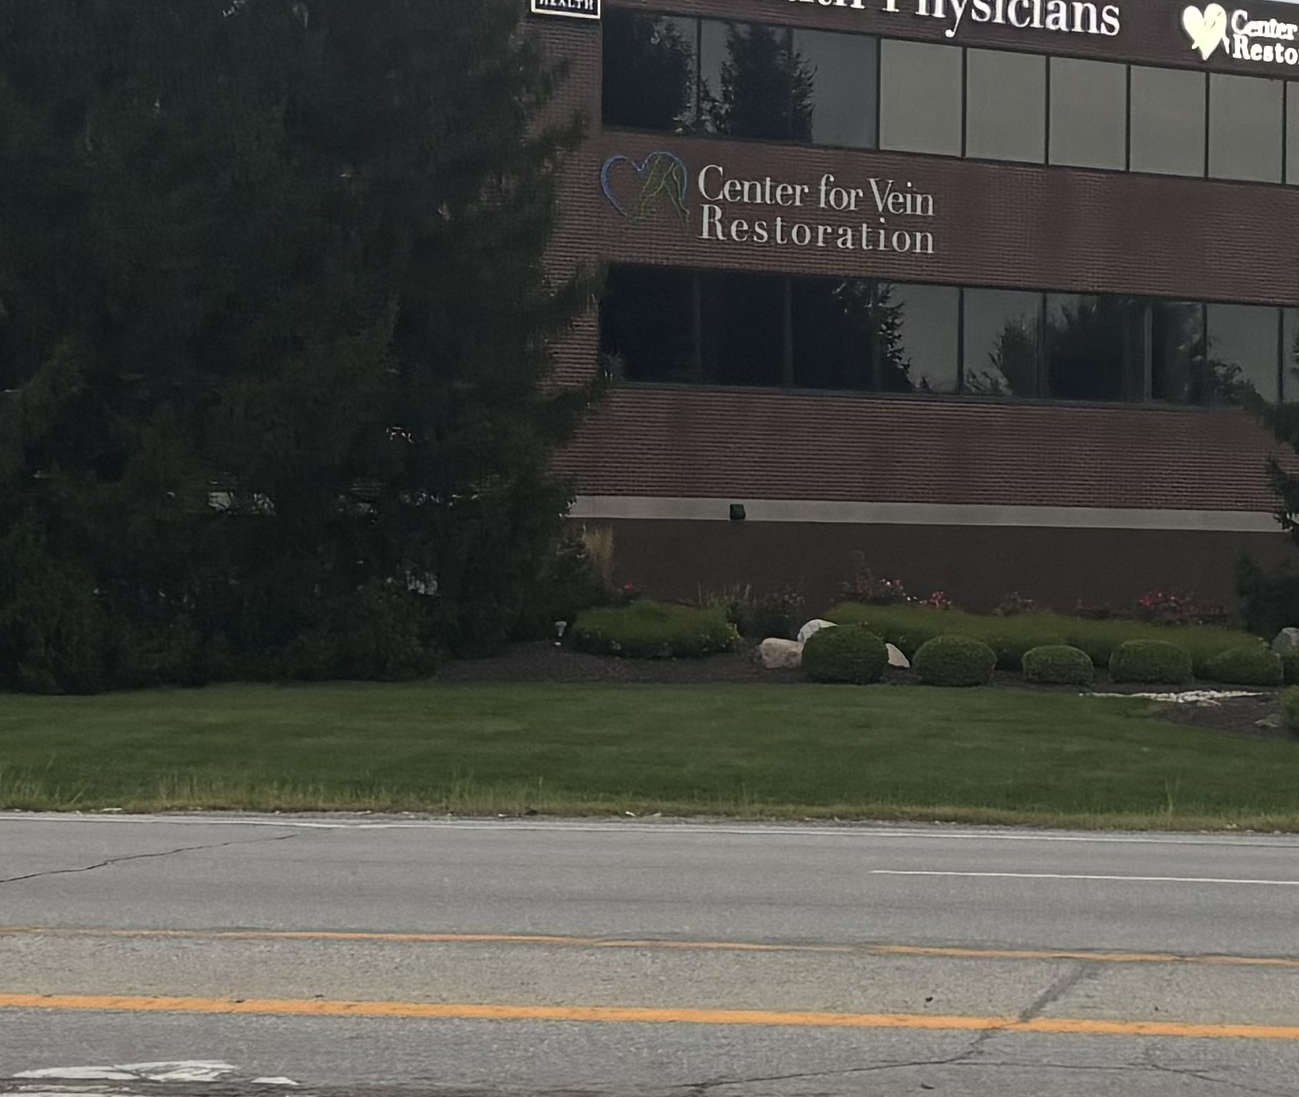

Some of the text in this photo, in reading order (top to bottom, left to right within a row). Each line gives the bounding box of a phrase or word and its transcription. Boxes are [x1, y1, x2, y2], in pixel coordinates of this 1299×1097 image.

[1231, 9, 1297, 41] Center
[697, 164, 935, 217] Center for Vein
[698, 203, 935, 254] Restoration
